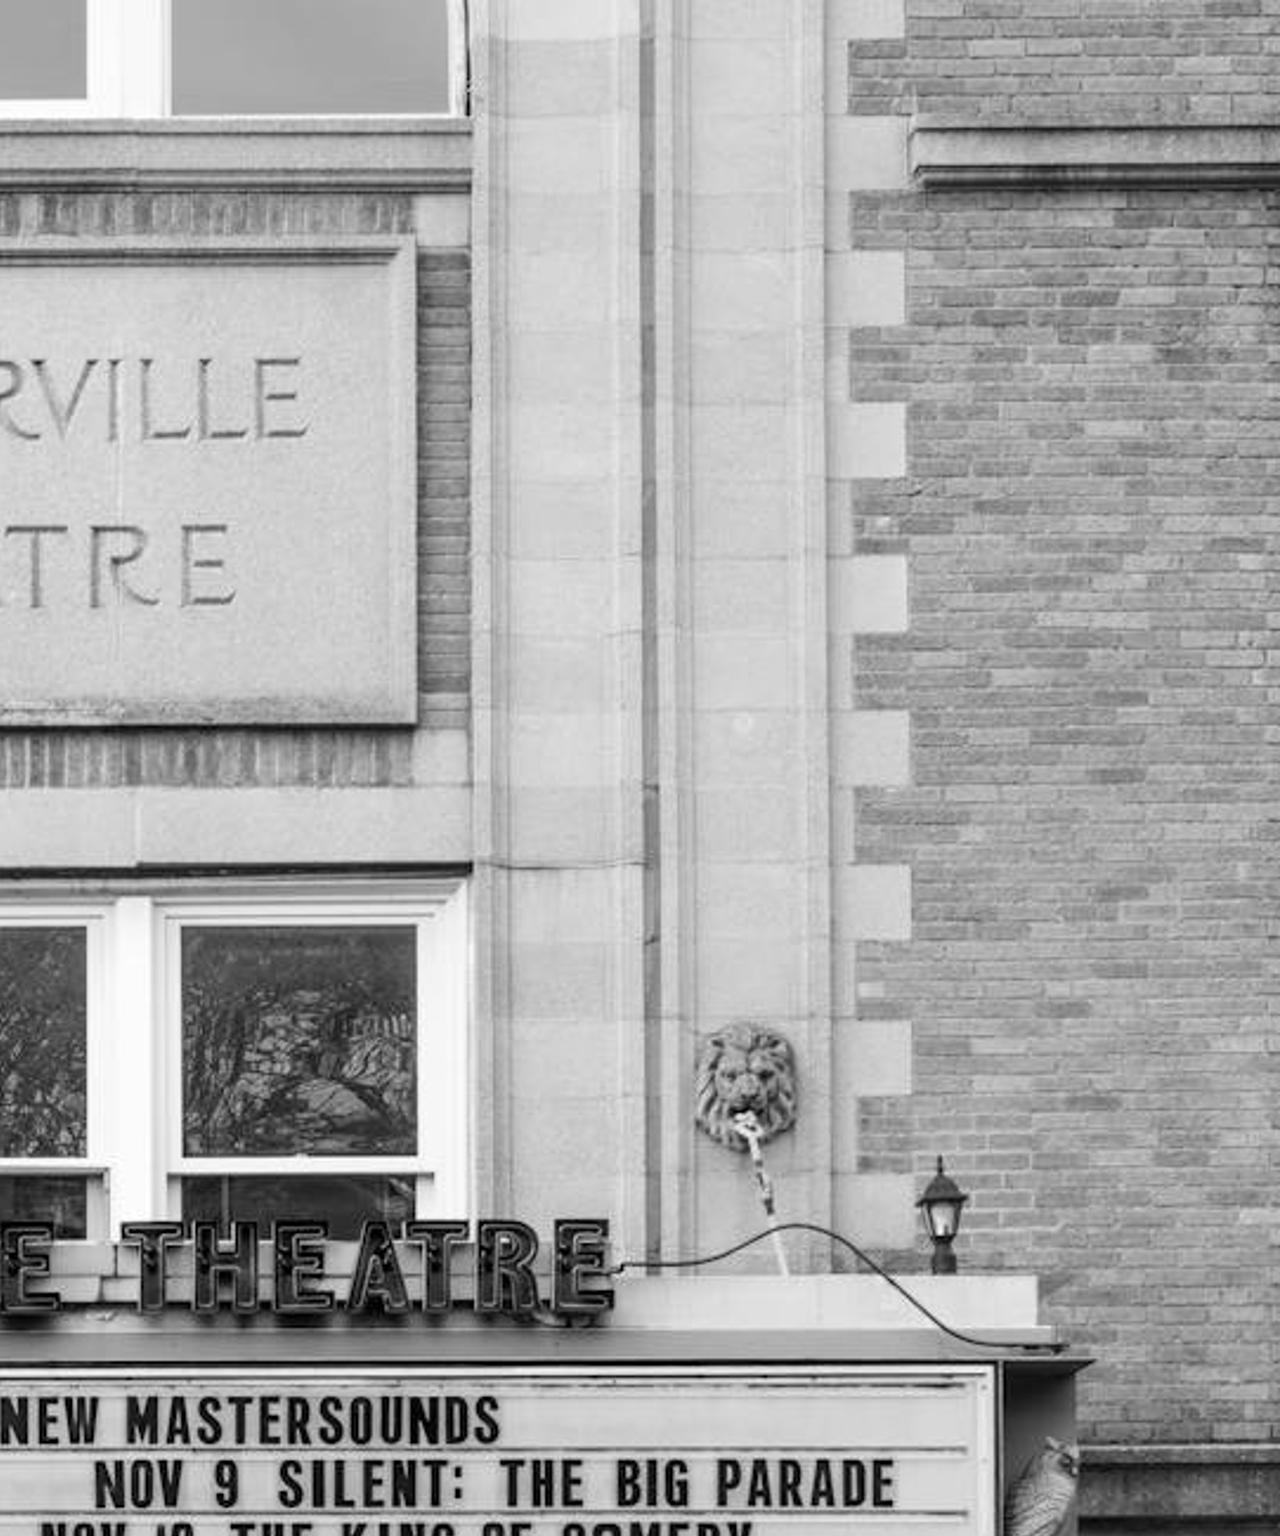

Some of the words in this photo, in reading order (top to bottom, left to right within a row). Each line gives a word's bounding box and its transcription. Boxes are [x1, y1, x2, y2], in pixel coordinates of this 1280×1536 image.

[121, 1219, 616, 1315] THEATRE
[0, 1396, 99, 1445] NEW
[126, 1395, 500, 1446] MASTERSOUNDS
[94, 1459, 183, 1509] NOV
[214, 1459, 239, 1509] 9
[278, 1459, 462, 1509] SILENT:
[499, 1459, 584, 1508] THE
[617, 1459, 689, 1508] BIG
[717, 1458, 894, 1508] PARADE
